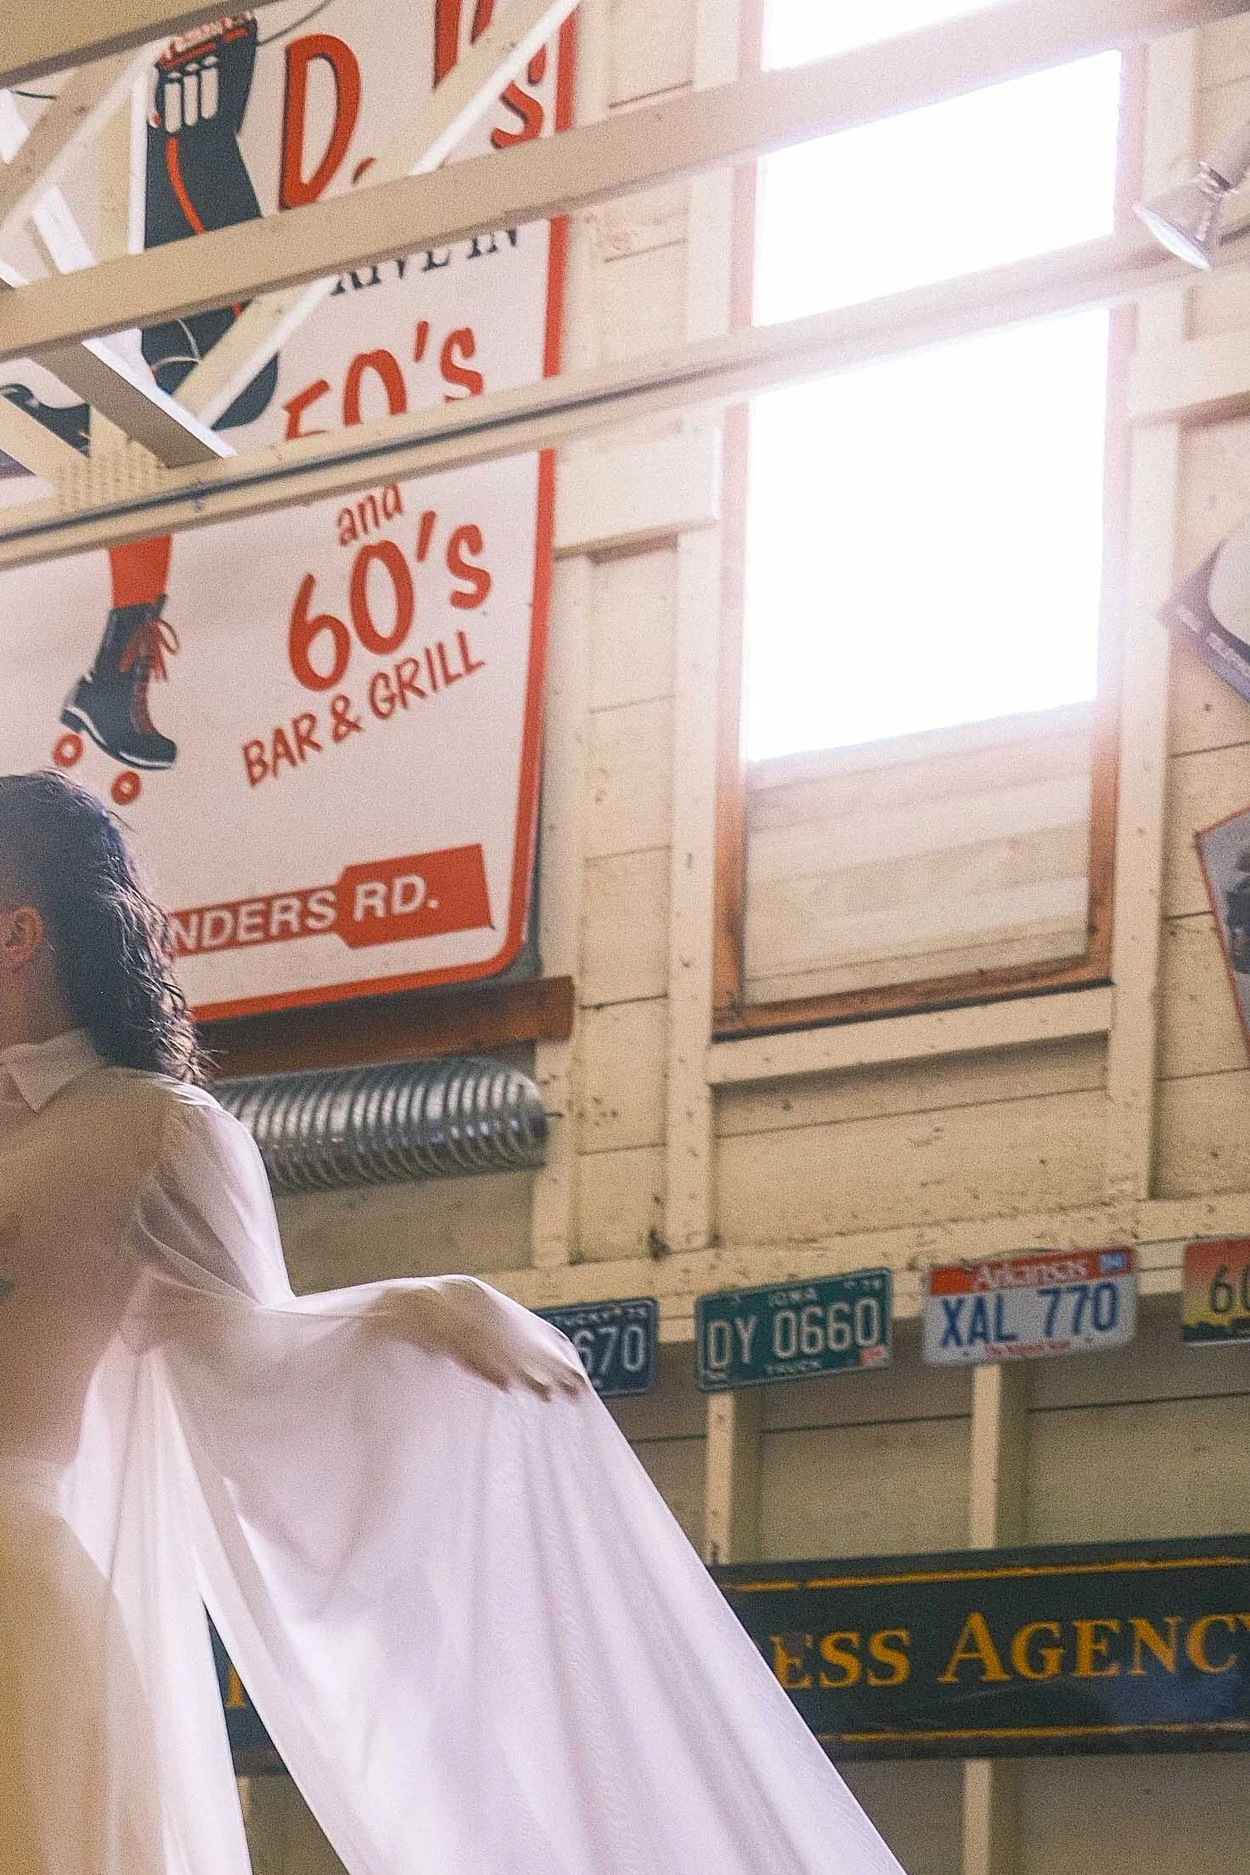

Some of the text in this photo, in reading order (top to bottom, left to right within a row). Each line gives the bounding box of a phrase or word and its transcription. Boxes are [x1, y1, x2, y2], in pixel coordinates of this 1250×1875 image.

[336, 482, 405, 547] and
[241, 629, 486, 788] BAR & GRILL
[352, 872, 441, 924] RD.
[772, 1296, 880, 1360] 0660
[940, 1280, 1120, 1348] XAL 770
